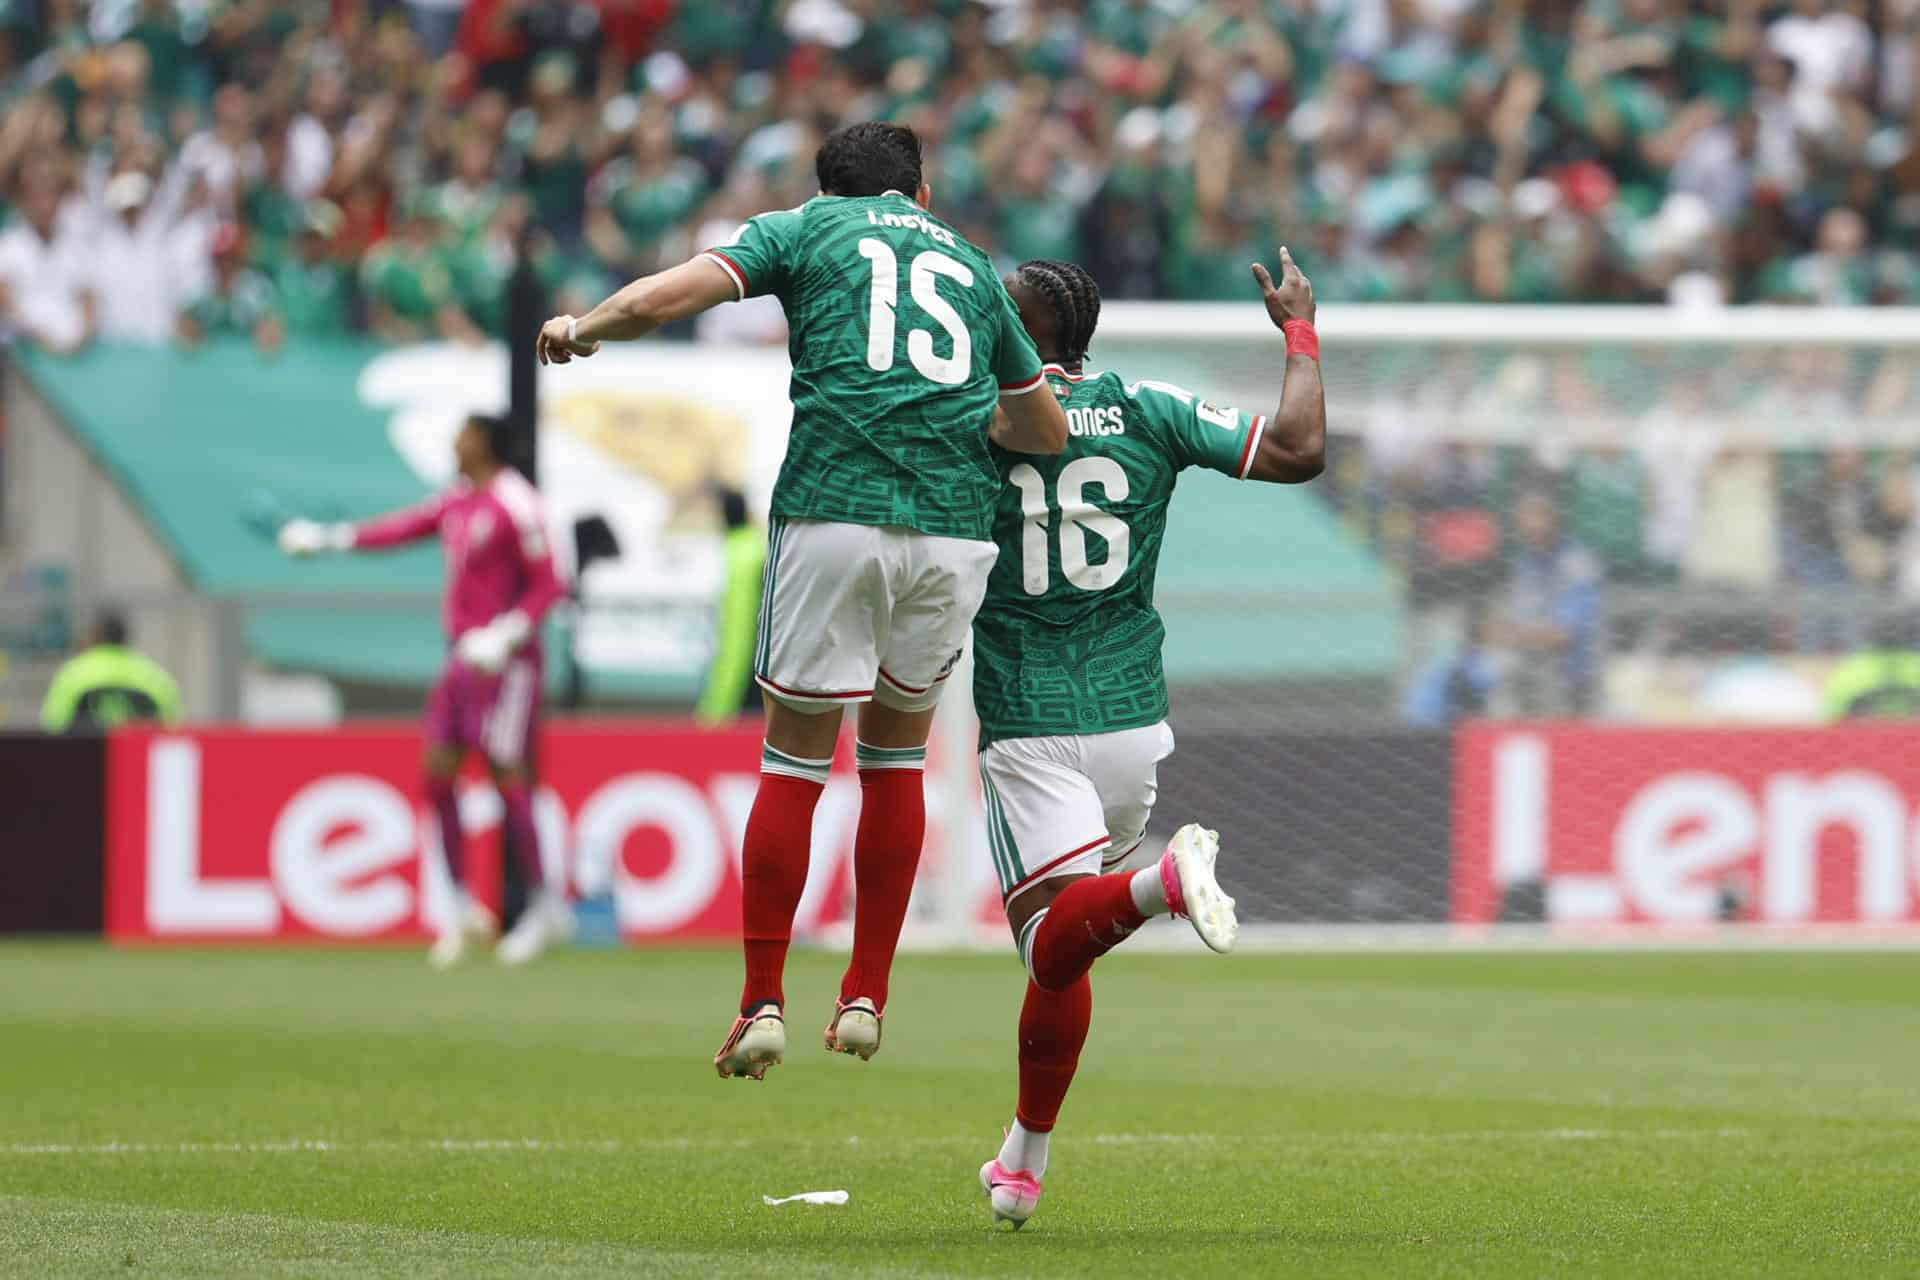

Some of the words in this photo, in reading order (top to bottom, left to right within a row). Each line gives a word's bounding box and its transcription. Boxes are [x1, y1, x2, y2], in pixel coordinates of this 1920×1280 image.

[858, 237, 974, 384] 15
[1066, 406, 1125, 437] ONES
[1009, 456, 1130, 596] 16
[1493, 734, 1920, 922] Len
